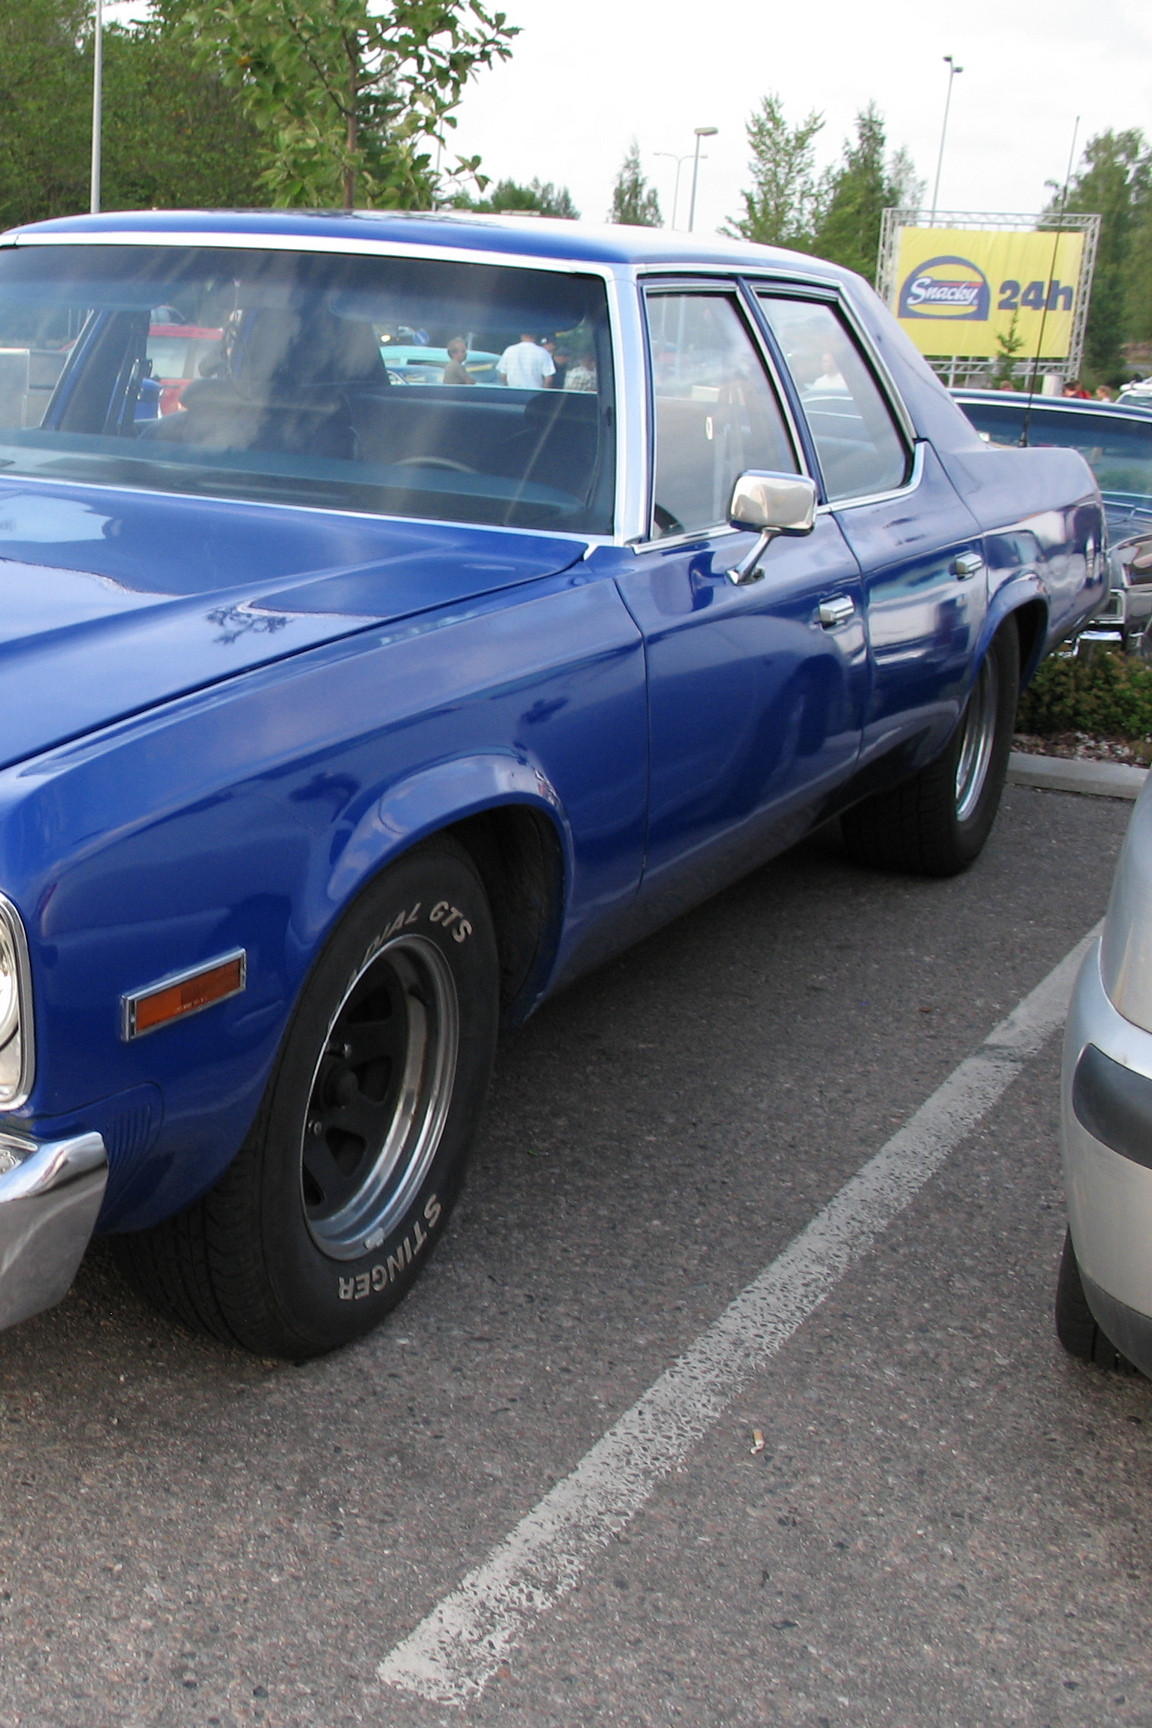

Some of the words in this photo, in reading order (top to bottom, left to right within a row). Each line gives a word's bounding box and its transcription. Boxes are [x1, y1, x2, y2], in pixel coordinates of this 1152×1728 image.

[907, 277, 980, 306] Snacky
[997, 279, 1074, 312] 24h
[429, 900, 473, 943] GTS
[338, 1193, 442, 1300] STINGER
